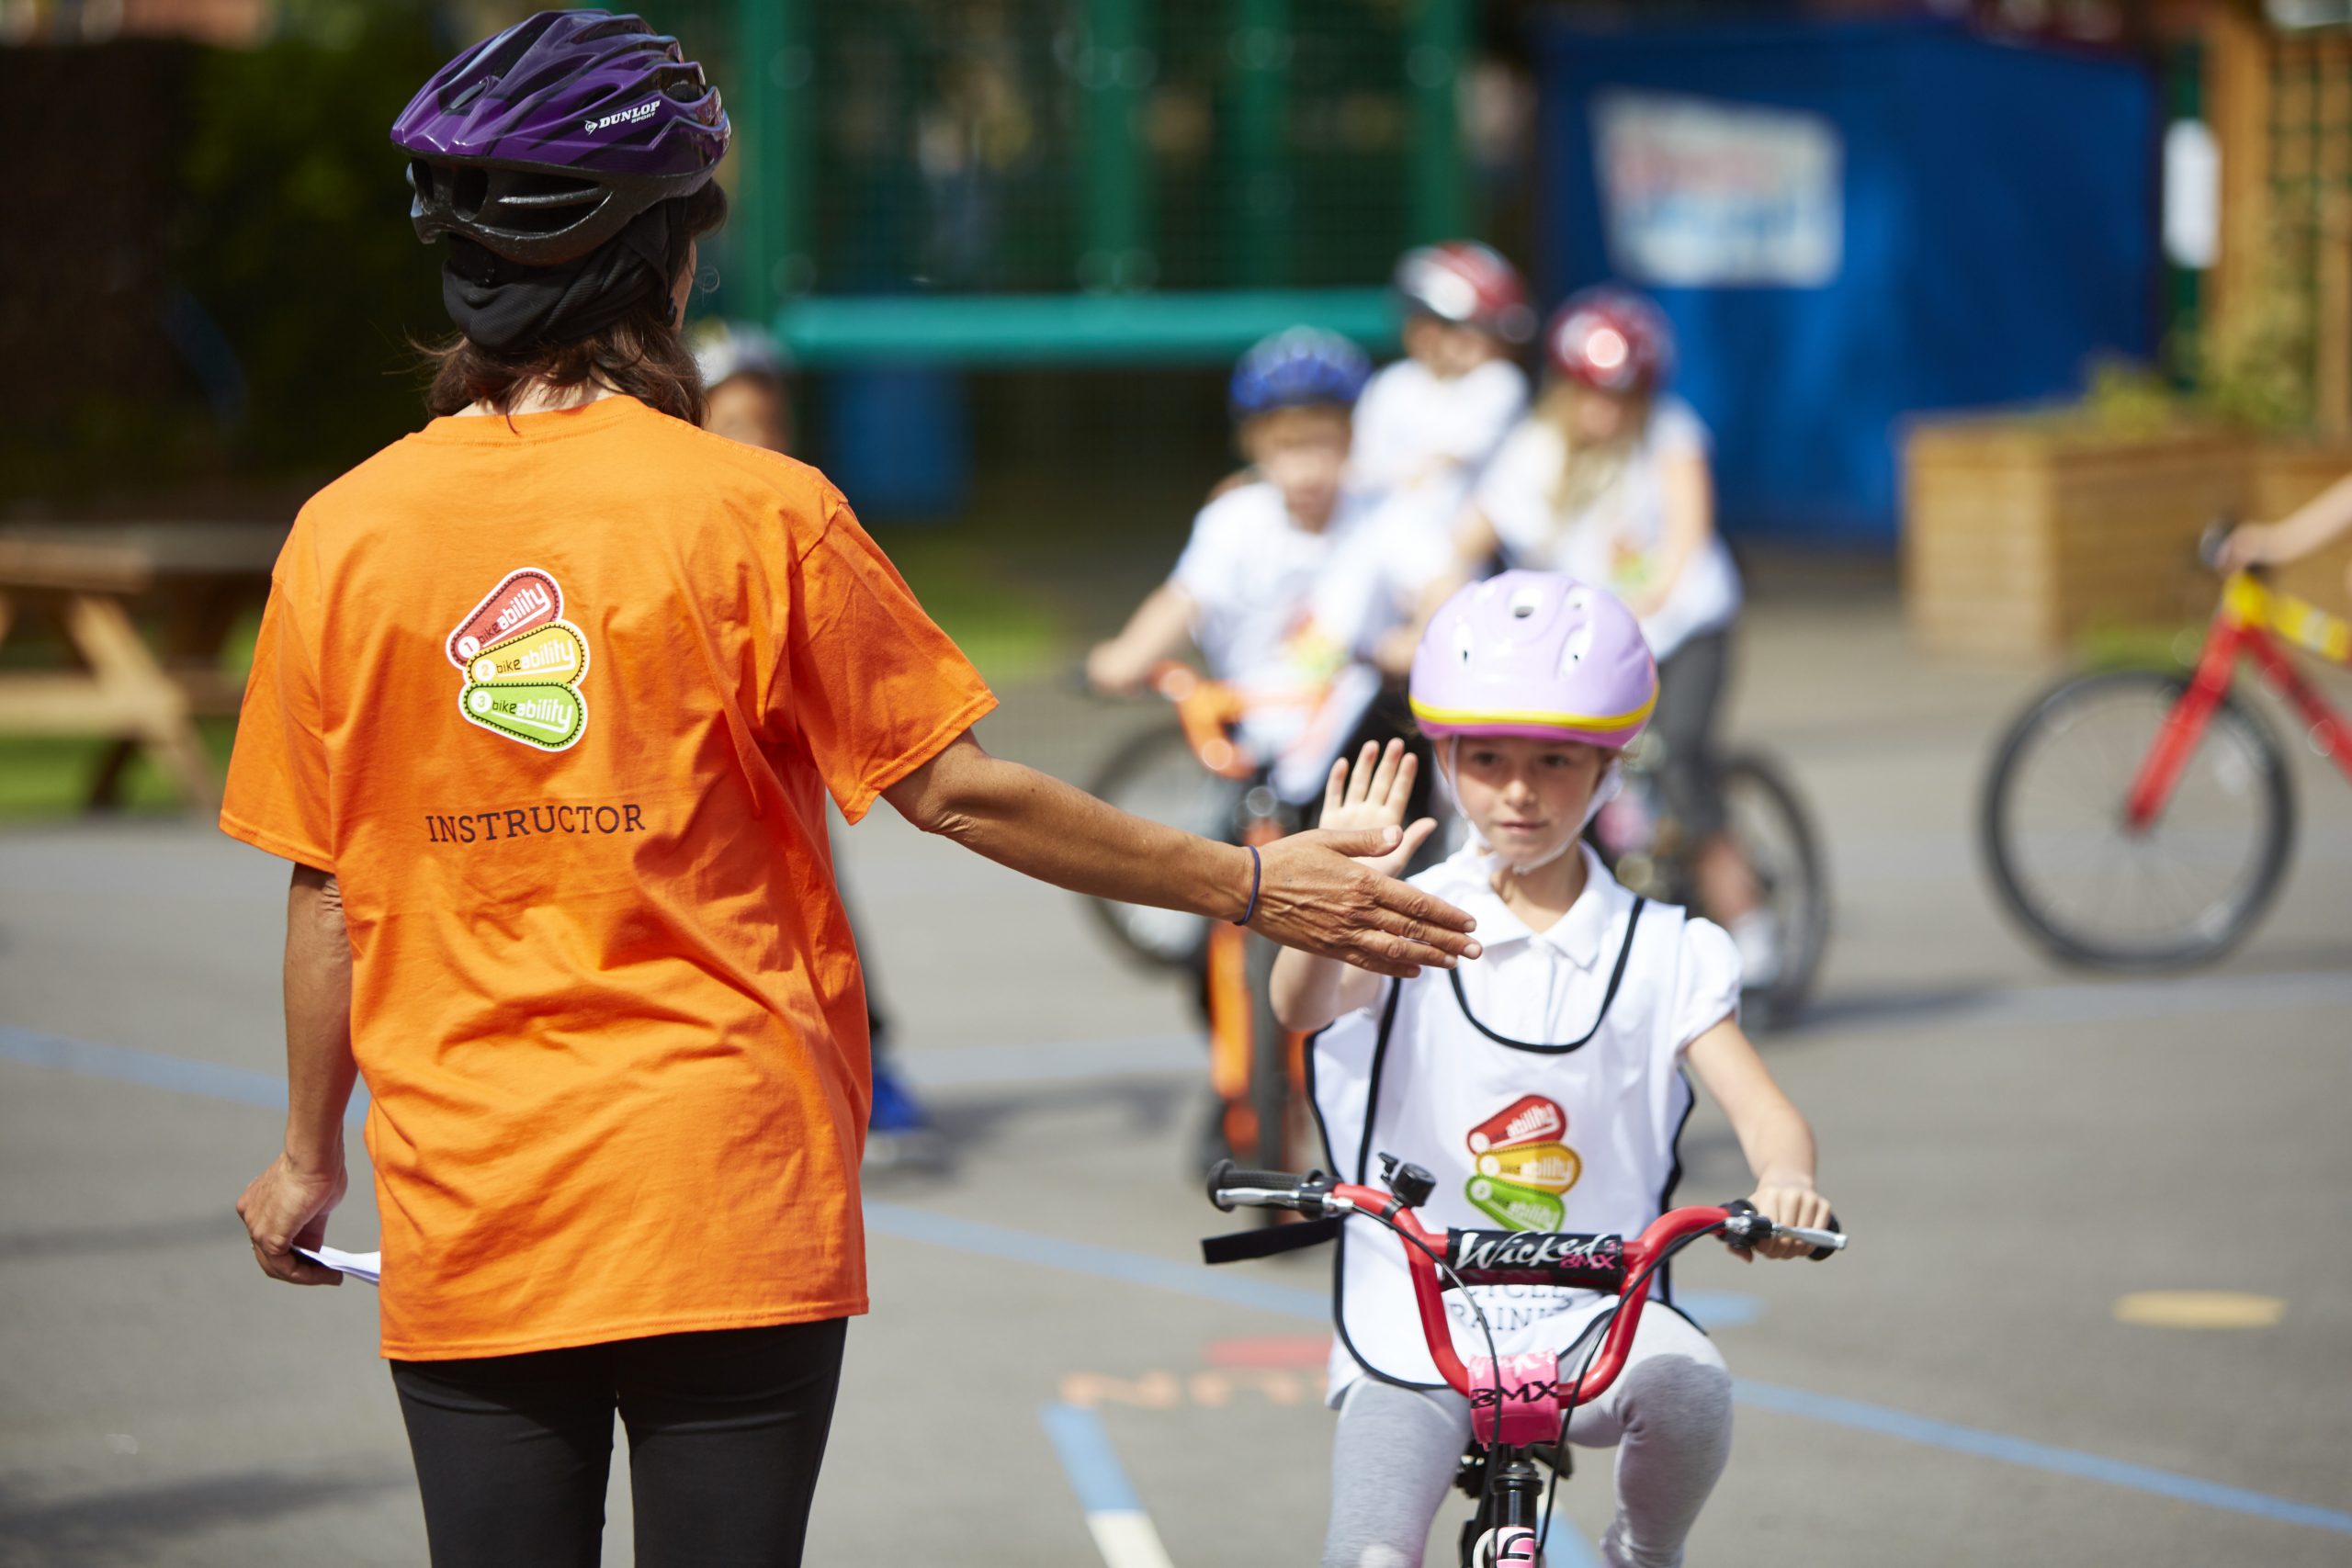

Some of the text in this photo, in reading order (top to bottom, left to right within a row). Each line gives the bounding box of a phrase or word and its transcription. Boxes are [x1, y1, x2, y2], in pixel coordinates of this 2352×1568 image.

[599, 99, 661, 129] DUNLOP
[631, 112, 655, 123] SPORT
[479, 583, 551, 648] bikeability
[496, 639, 575, 677] bikeability
[492, 699, 572, 733] bikeability
[425, 805, 646, 843] INSTRUCTOR
[1454, 1231, 1610, 1269] Wicked
[1471, 1381, 1558, 1408] BMX
